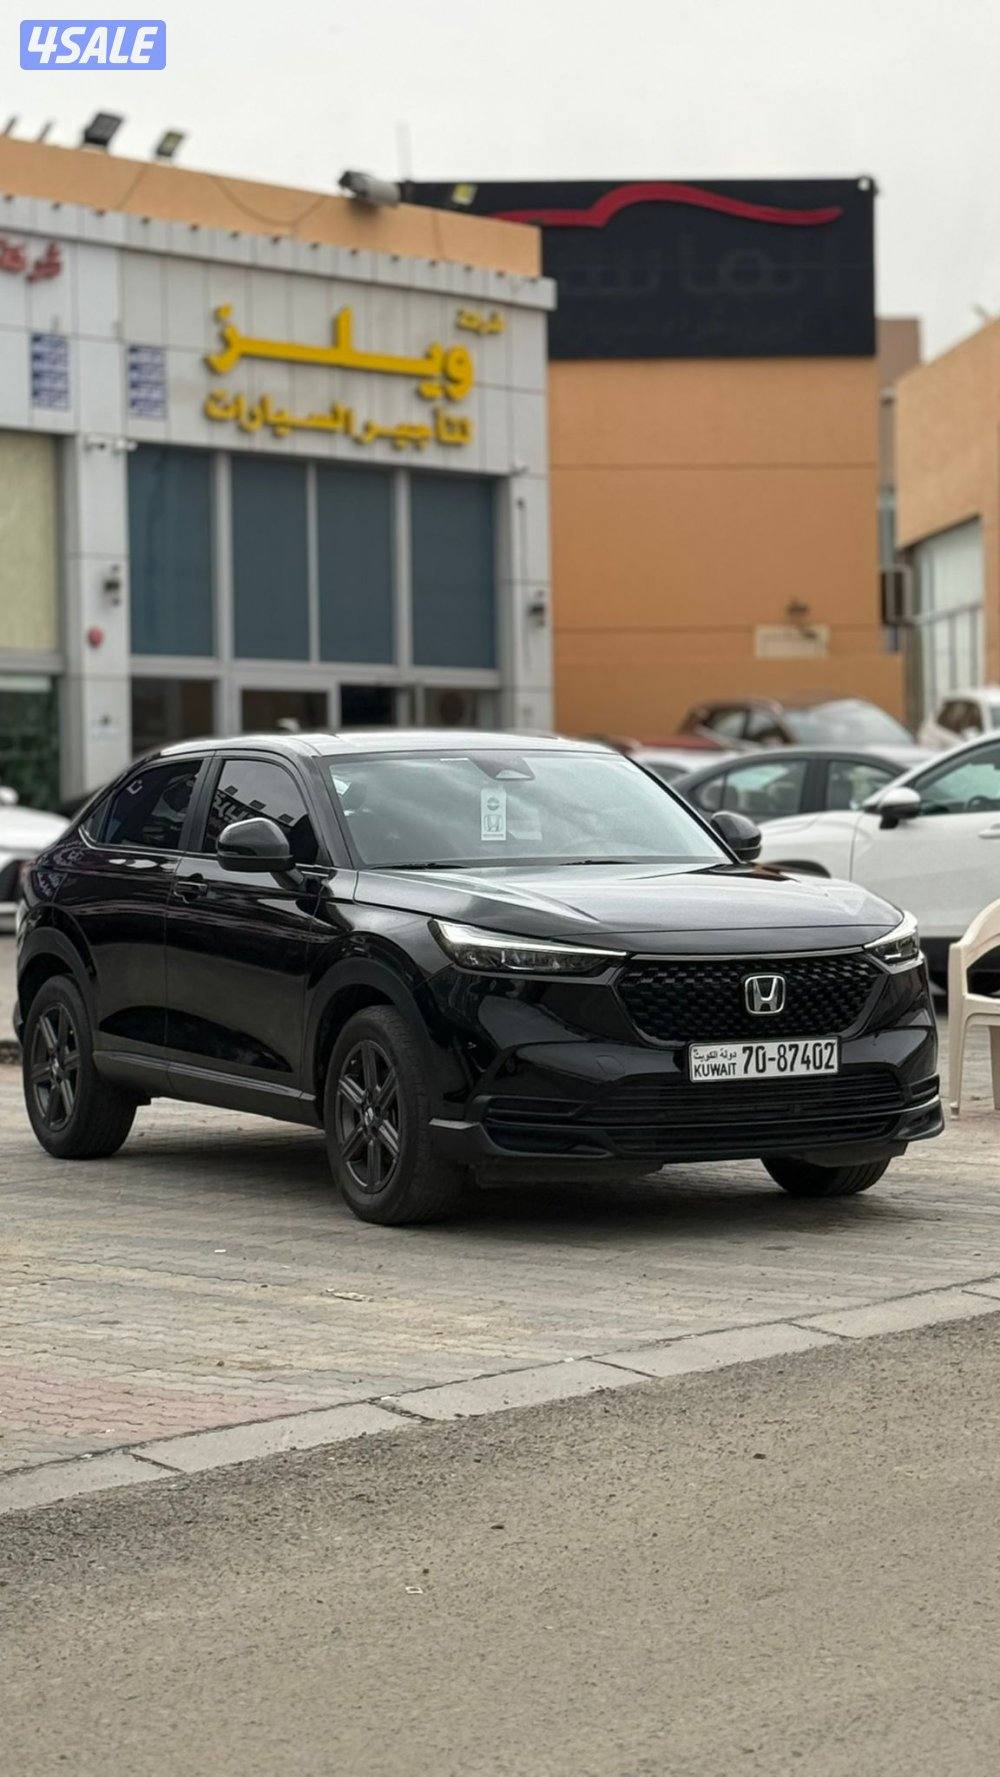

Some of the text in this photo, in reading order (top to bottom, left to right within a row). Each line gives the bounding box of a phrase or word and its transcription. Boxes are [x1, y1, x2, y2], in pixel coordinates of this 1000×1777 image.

[204, 304, 473, 399] ويلز
[204, 388, 355, 437] السيارات
[693, 1048, 737, 1062] دولة الكويت
[694, 1062, 737, 1077] KUWAIT
[742, 1042, 835, 1074] 70-87402
